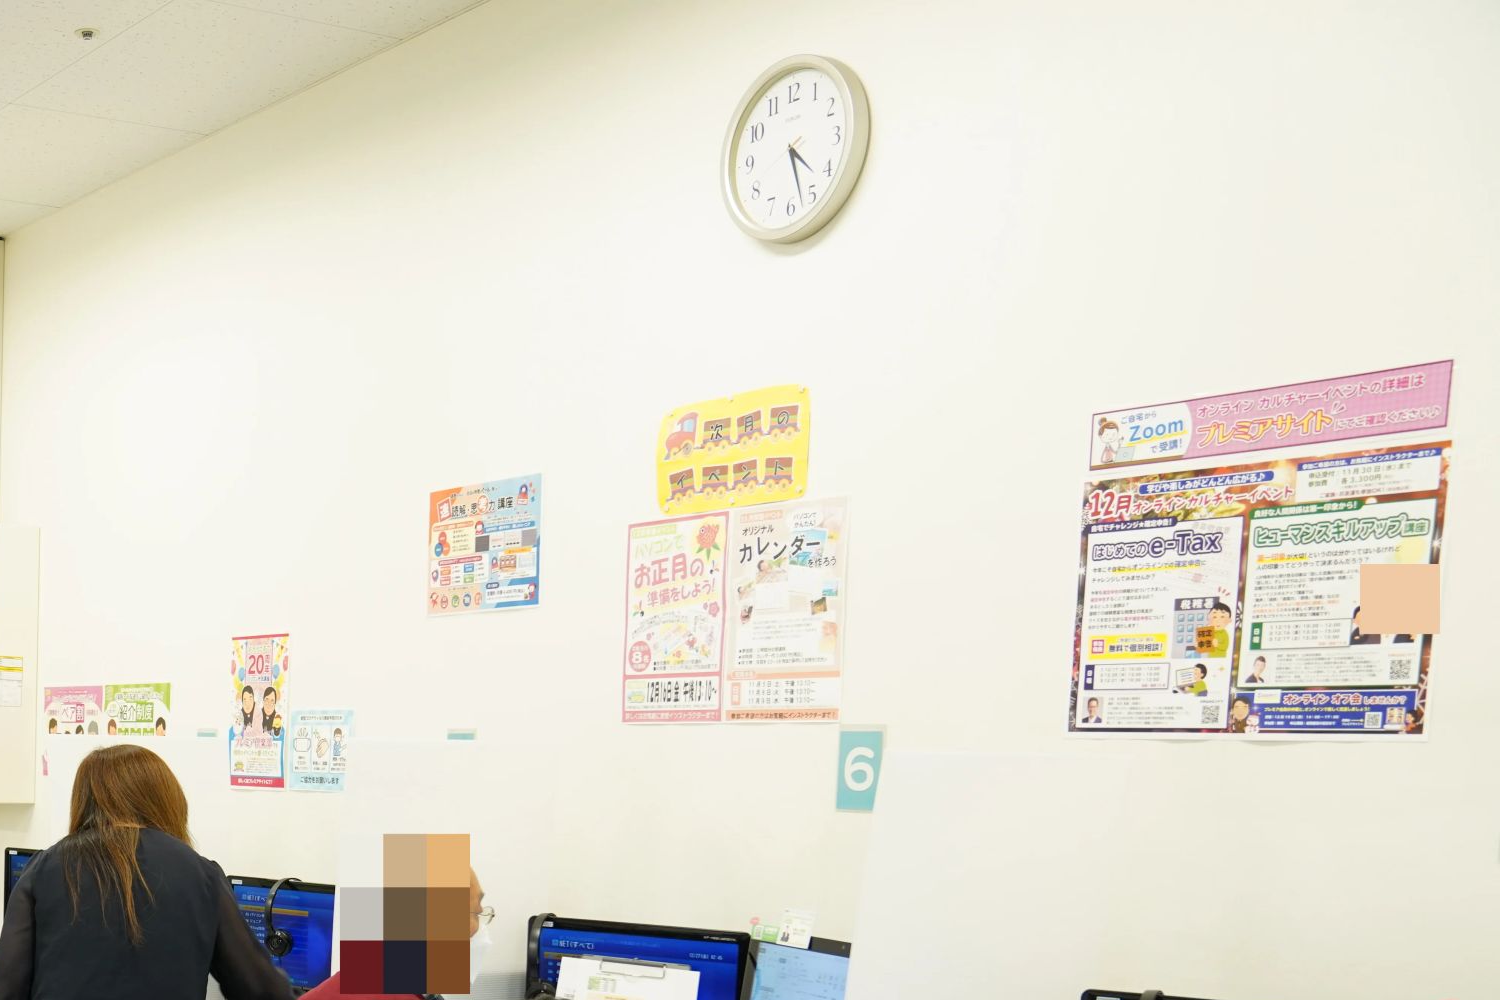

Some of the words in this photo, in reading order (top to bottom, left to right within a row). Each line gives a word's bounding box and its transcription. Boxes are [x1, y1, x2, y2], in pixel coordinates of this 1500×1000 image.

[787, 82, 801, 105] 12
[812, 82, 818, 101] 1
[767, 96, 779, 117] 11
[826, 97, 835, 117] 2
[750, 122, 765, 144] 10
[831, 125, 841, 146] 3
[745, 155, 755, 175] 9
[822, 159, 833, 177] 4
[751, 180, 761, 200] 8
[807, 184, 818, 205] 5
[767, 197, 776, 217] 7
[786, 197, 796, 217] 6
[1197, 400, 1254, 418] オンライン
[1129, 418, 1184, 443] Zoom
[677, 460, 785, 489] イベント
[1255, 515, 1428, 546] ヒューマンスキルアップ講座
[739, 534, 821, 564] カレンダー
[634, 553, 705, 589] お正月の
[1283, 693, 1330, 705] オンライン
[844, 746, 875, 791] 6
